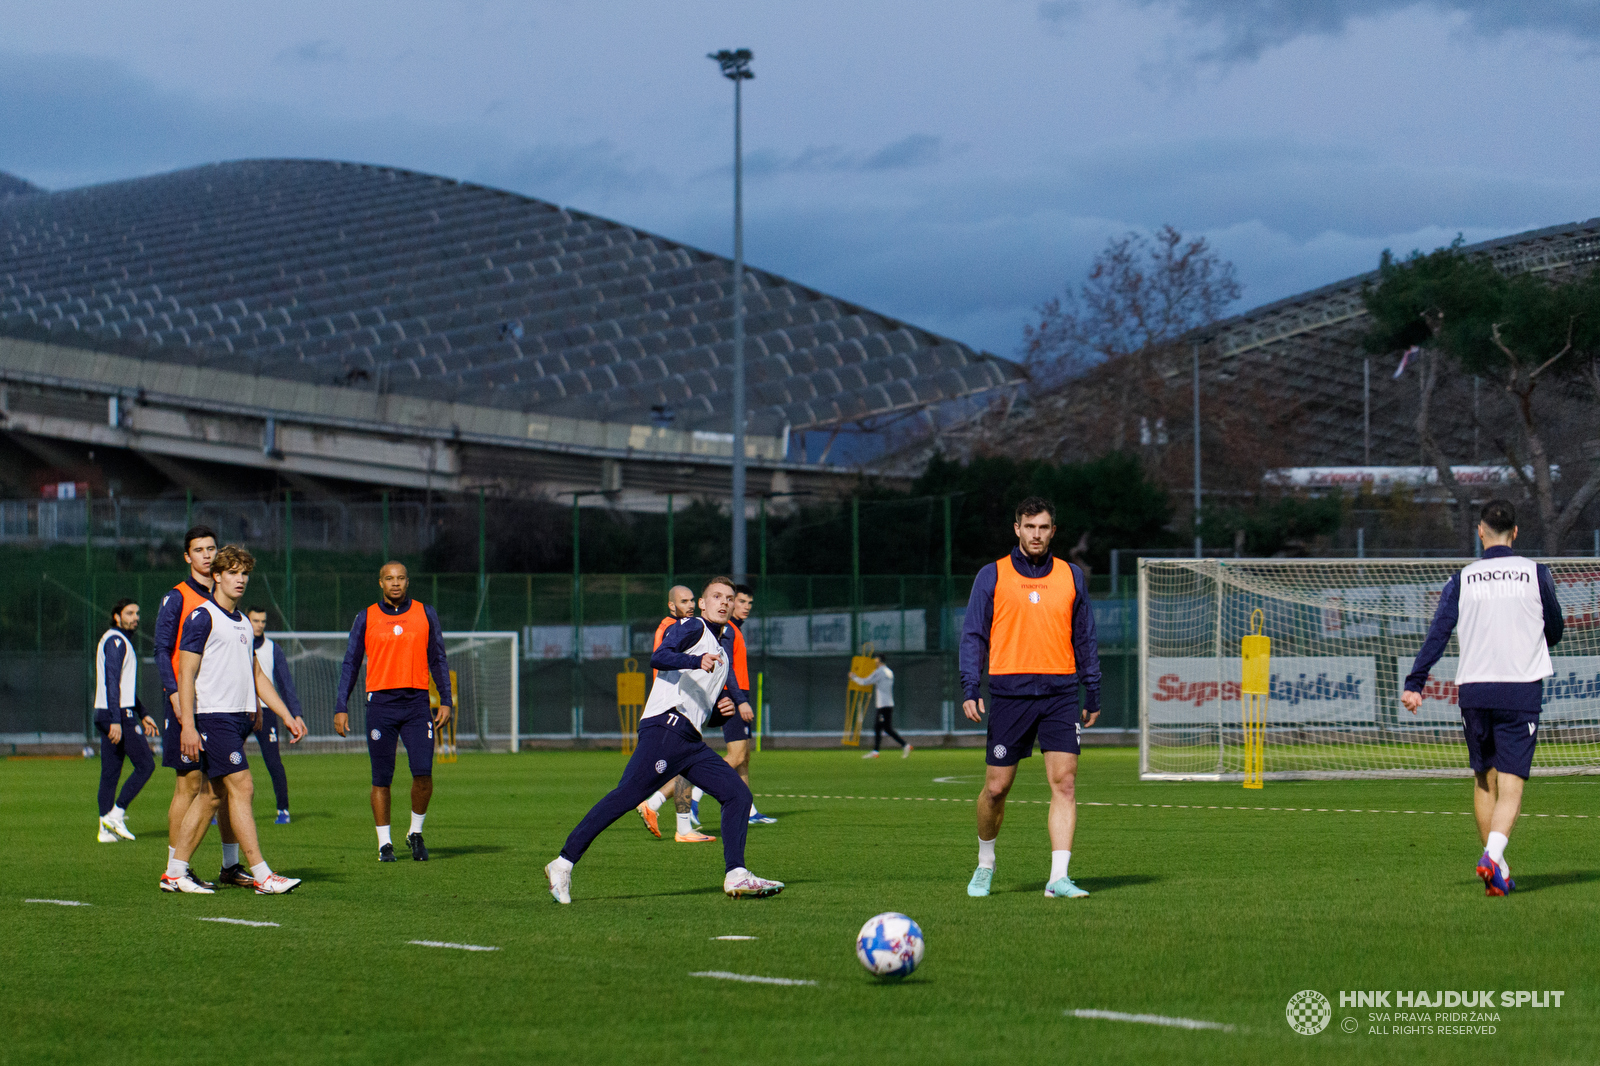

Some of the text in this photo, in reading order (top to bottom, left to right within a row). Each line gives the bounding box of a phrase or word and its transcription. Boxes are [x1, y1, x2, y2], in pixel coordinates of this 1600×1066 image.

[1467, 570, 1530, 584] macron
[666, 713, 680, 727] 77
[427, 729, 433, 739] 8
